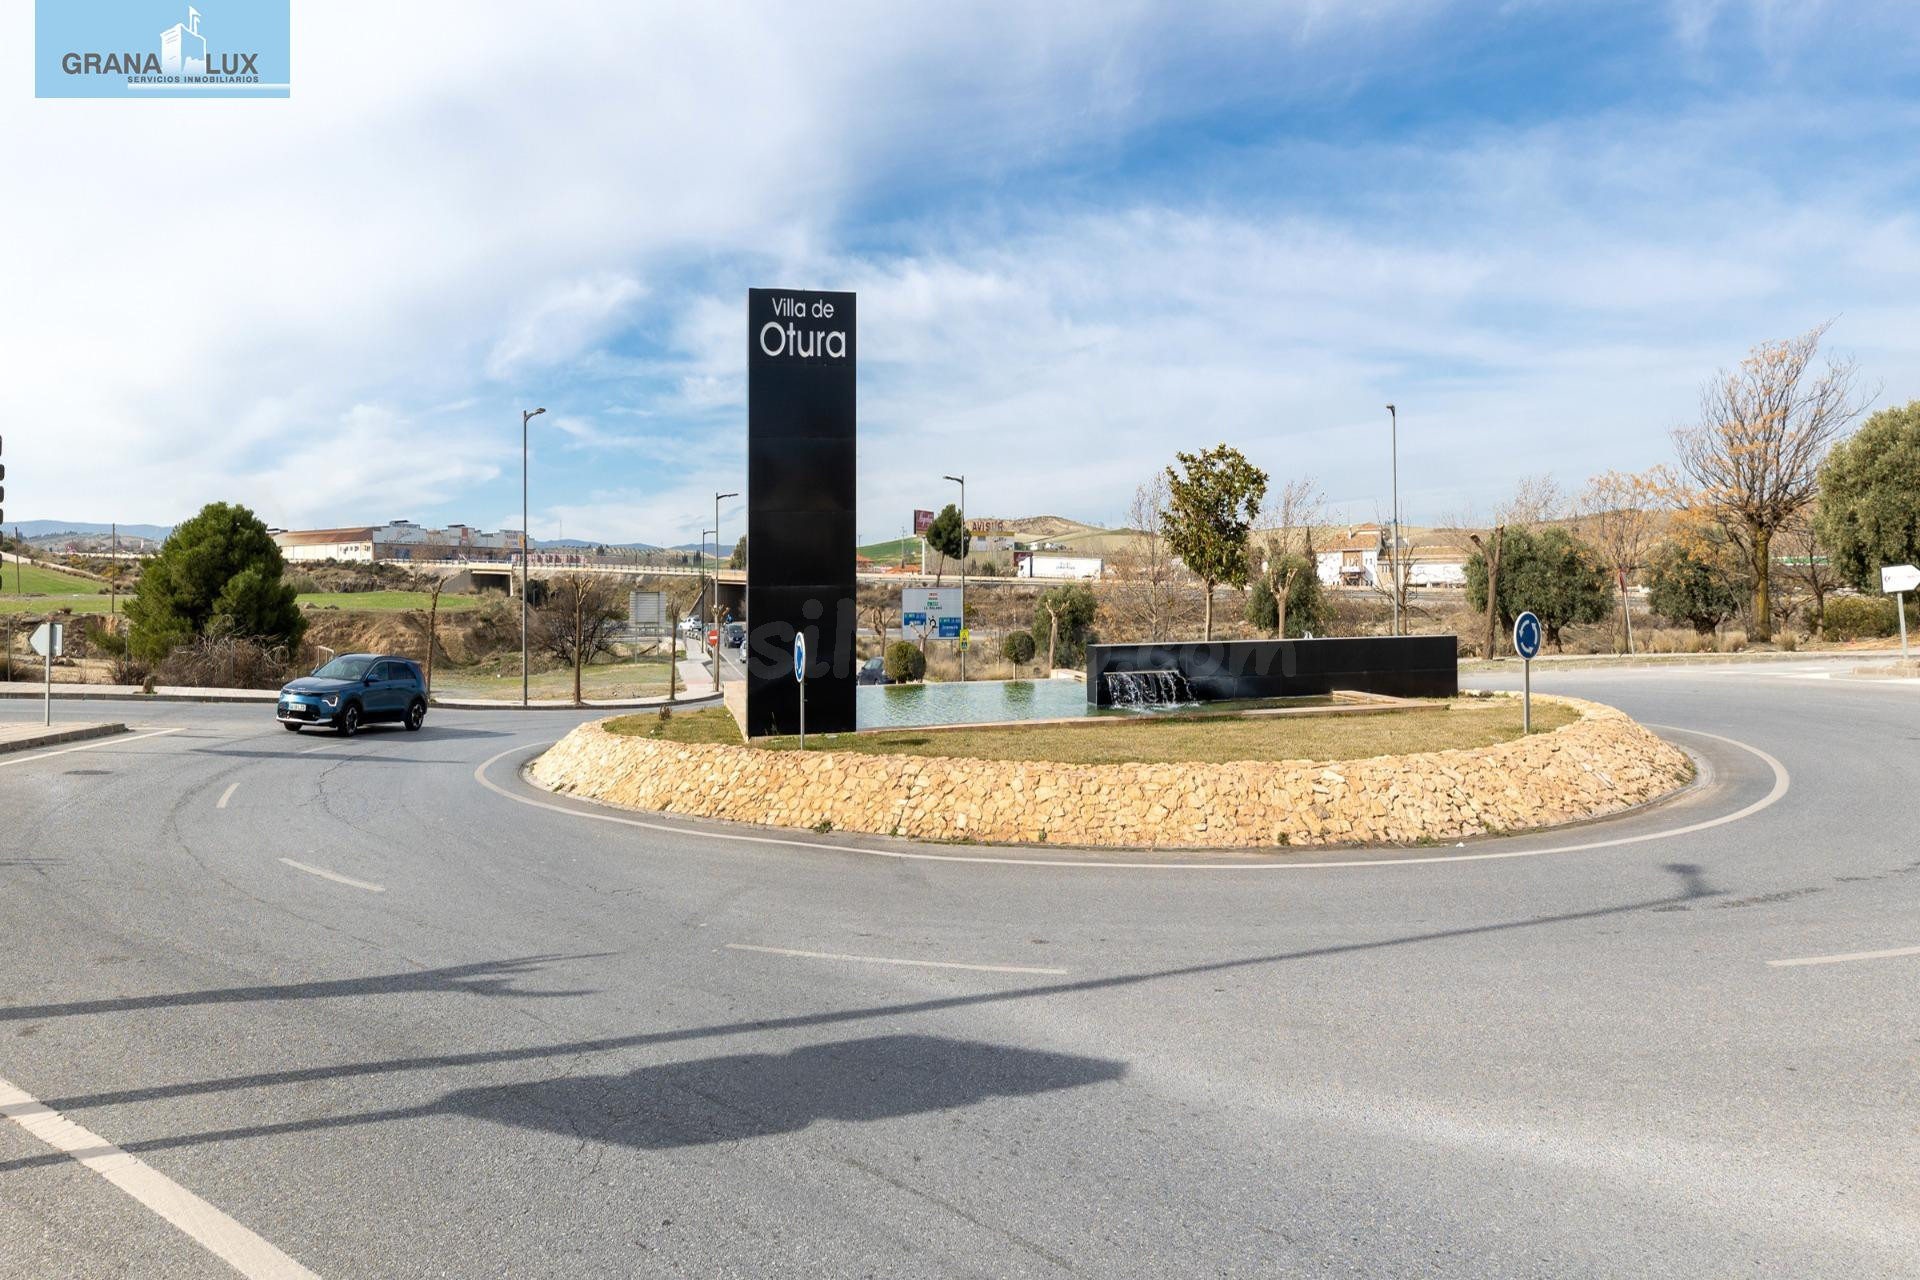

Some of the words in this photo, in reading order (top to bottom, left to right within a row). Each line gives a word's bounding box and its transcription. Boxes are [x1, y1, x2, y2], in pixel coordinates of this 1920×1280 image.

[772, 297, 806, 318] Villa
[811, 299, 835, 319] de
[760, 321, 846, 358] Otura
